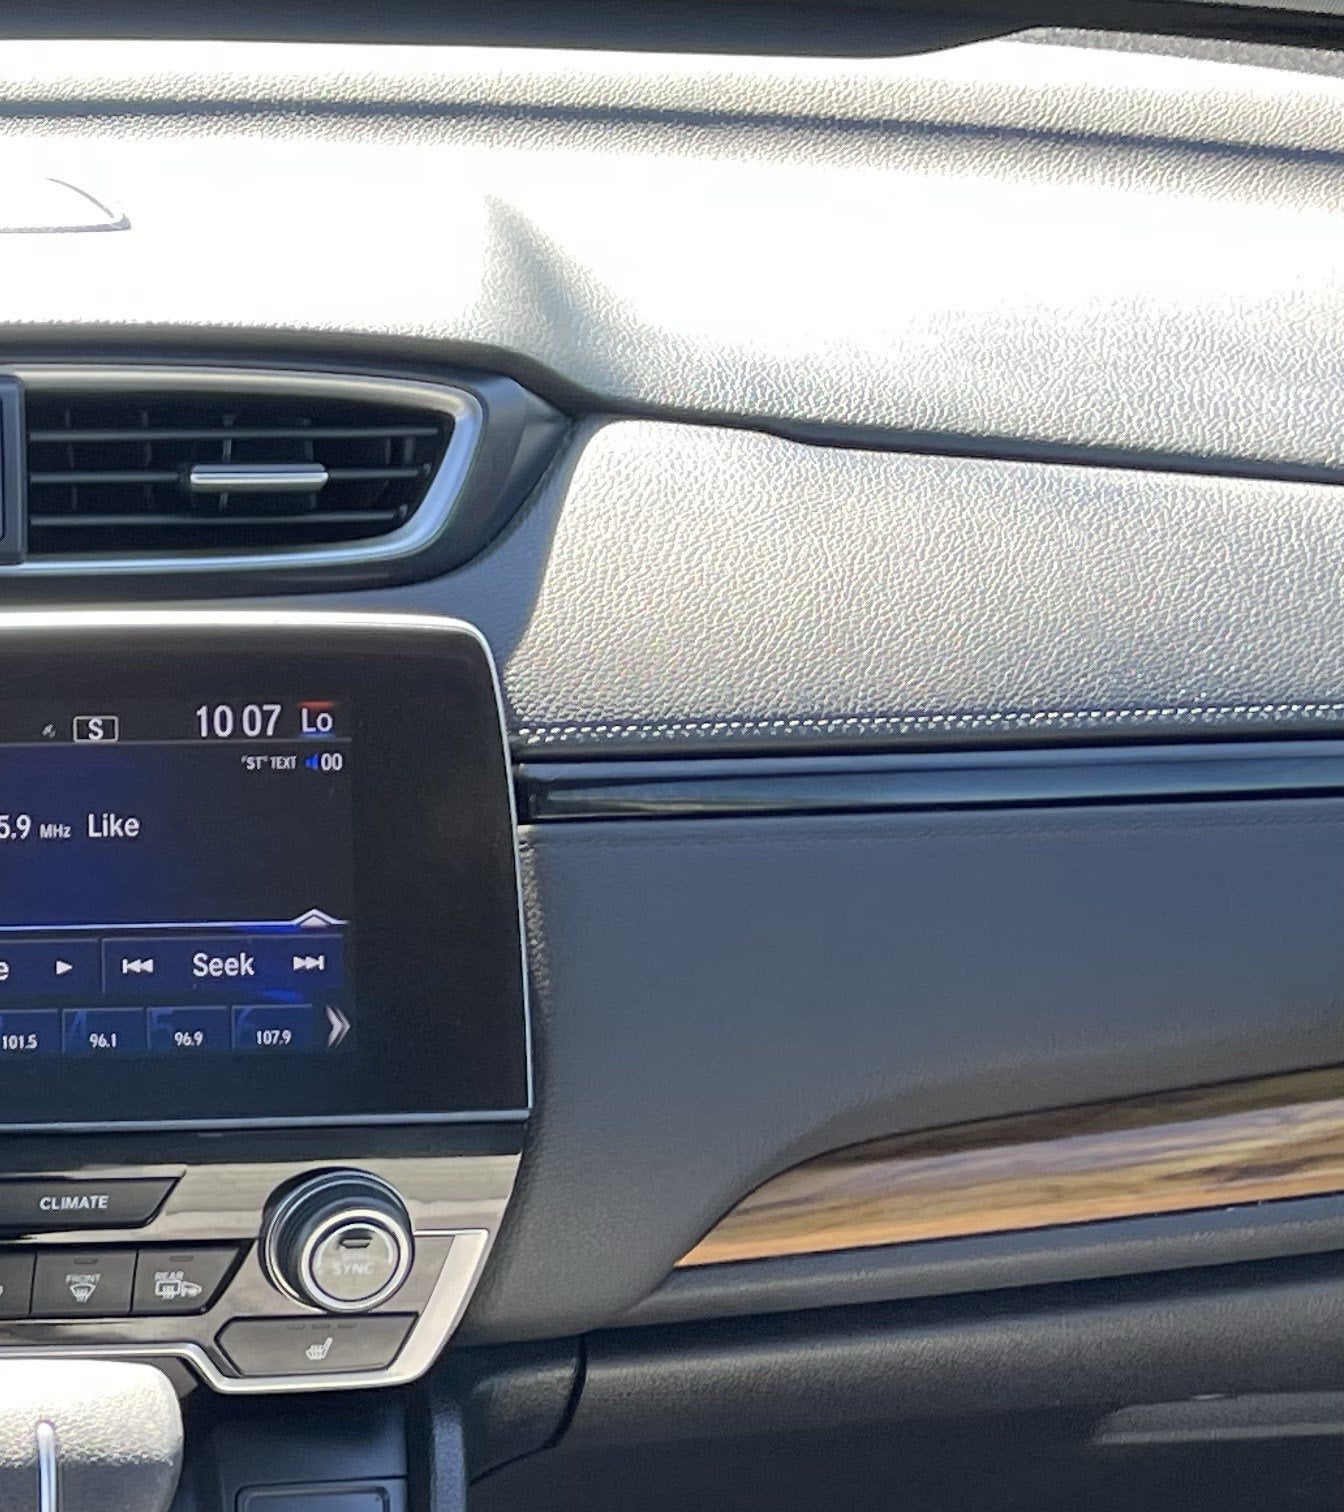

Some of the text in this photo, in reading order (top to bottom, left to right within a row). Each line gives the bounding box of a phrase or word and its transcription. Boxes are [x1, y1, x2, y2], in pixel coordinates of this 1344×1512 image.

[301, 707, 334, 734] Lo
[270, 754, 297, 770] TEXT
[320, 753, 343, 771] 00
[38, 825, 72, 839] MHz
[87, 812, 141, 839] Like
[192, 951, 256, 978] Seek
[1, 1033, 39, 1051] 101.5
[88, 1032, 118, 1050] 96.1
[173, 1030, 205, 1047] 96.9
[255, 1029, 293, 1046] 107.9
[39, 1194, 109, 1211] CLIMATE
[154, 1271, 185, 1281] REAR
[333, 1262, 373, 1276] SYNC
